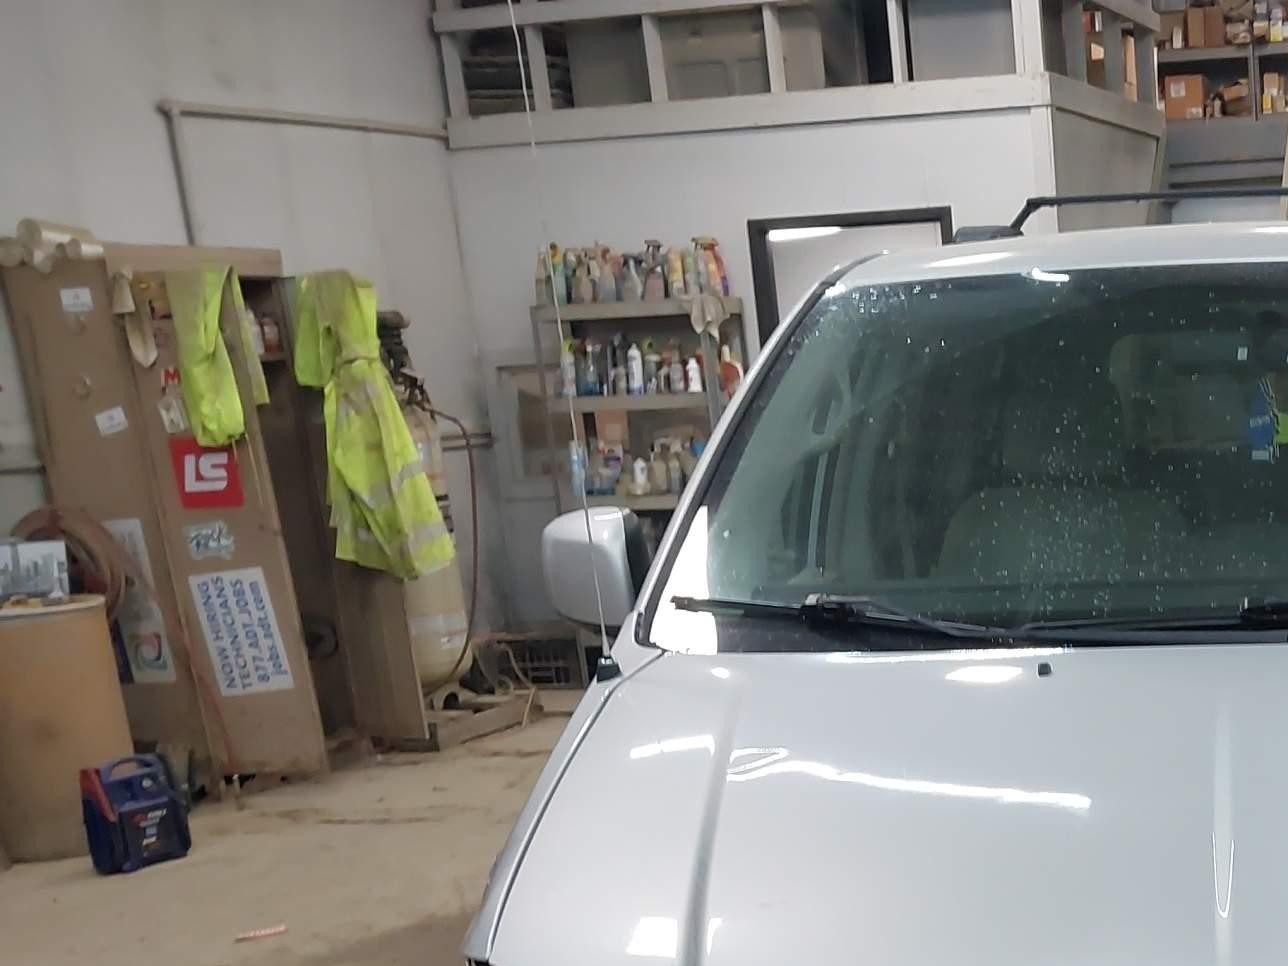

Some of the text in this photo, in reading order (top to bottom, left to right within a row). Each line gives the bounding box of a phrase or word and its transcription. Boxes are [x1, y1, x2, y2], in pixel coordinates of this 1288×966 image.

[184, 452, 229, 493] LS
[197, 581, 224, 641] HIRING
[211, 576, 252, 690] TECHNICIANS
[216, 646, 238, 689] NOW
